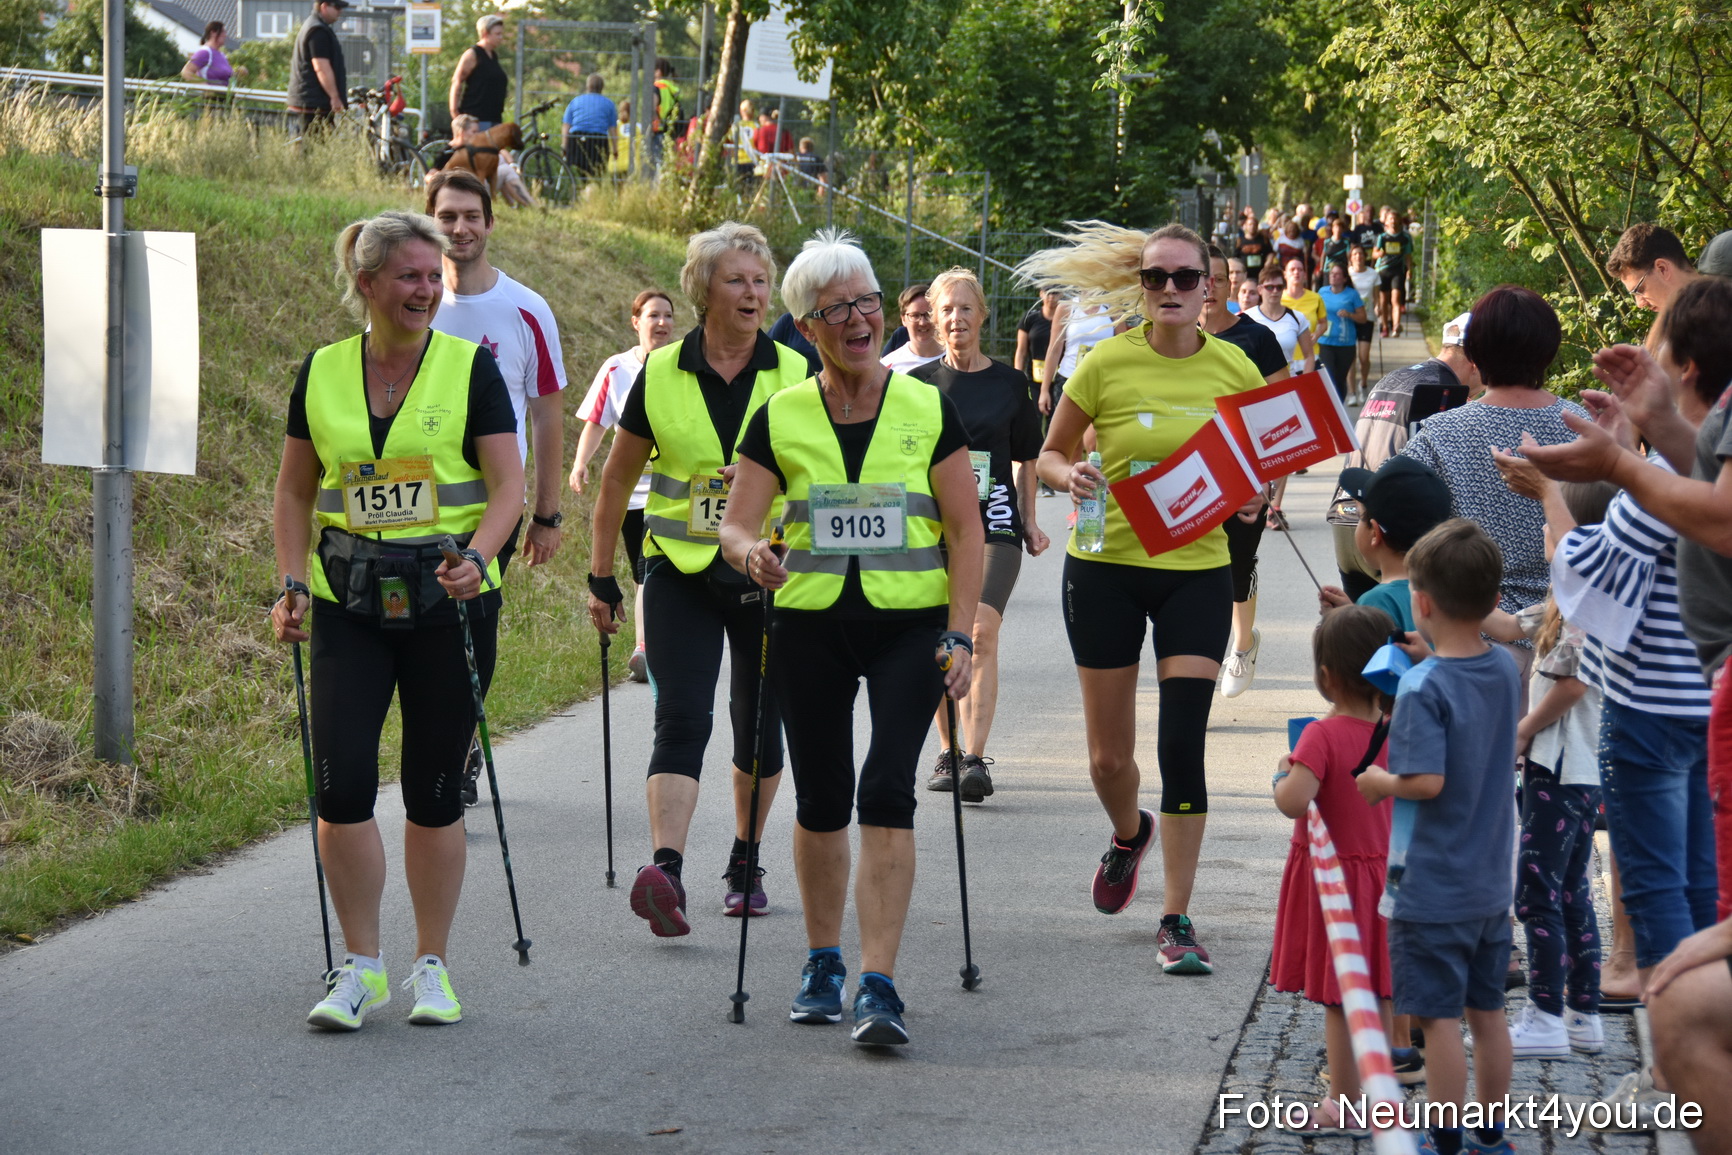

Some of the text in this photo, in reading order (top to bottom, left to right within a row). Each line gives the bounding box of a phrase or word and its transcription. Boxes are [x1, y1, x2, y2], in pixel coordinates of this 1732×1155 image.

[1271, 425, 1290, 441] DEHN
[1260, 444, 1321, 469] DEHN protects.
[354, 472, 389, 482] firmenlauf
[354, 482, 423, 512] 1517
[1180, 488, 1197, 509] DEHN
[368, 509, 413, 519] Pröll Claudia
[1169, 499, 1228, 537] DEHN protects.
[830, 515, 886, 538] 9103
